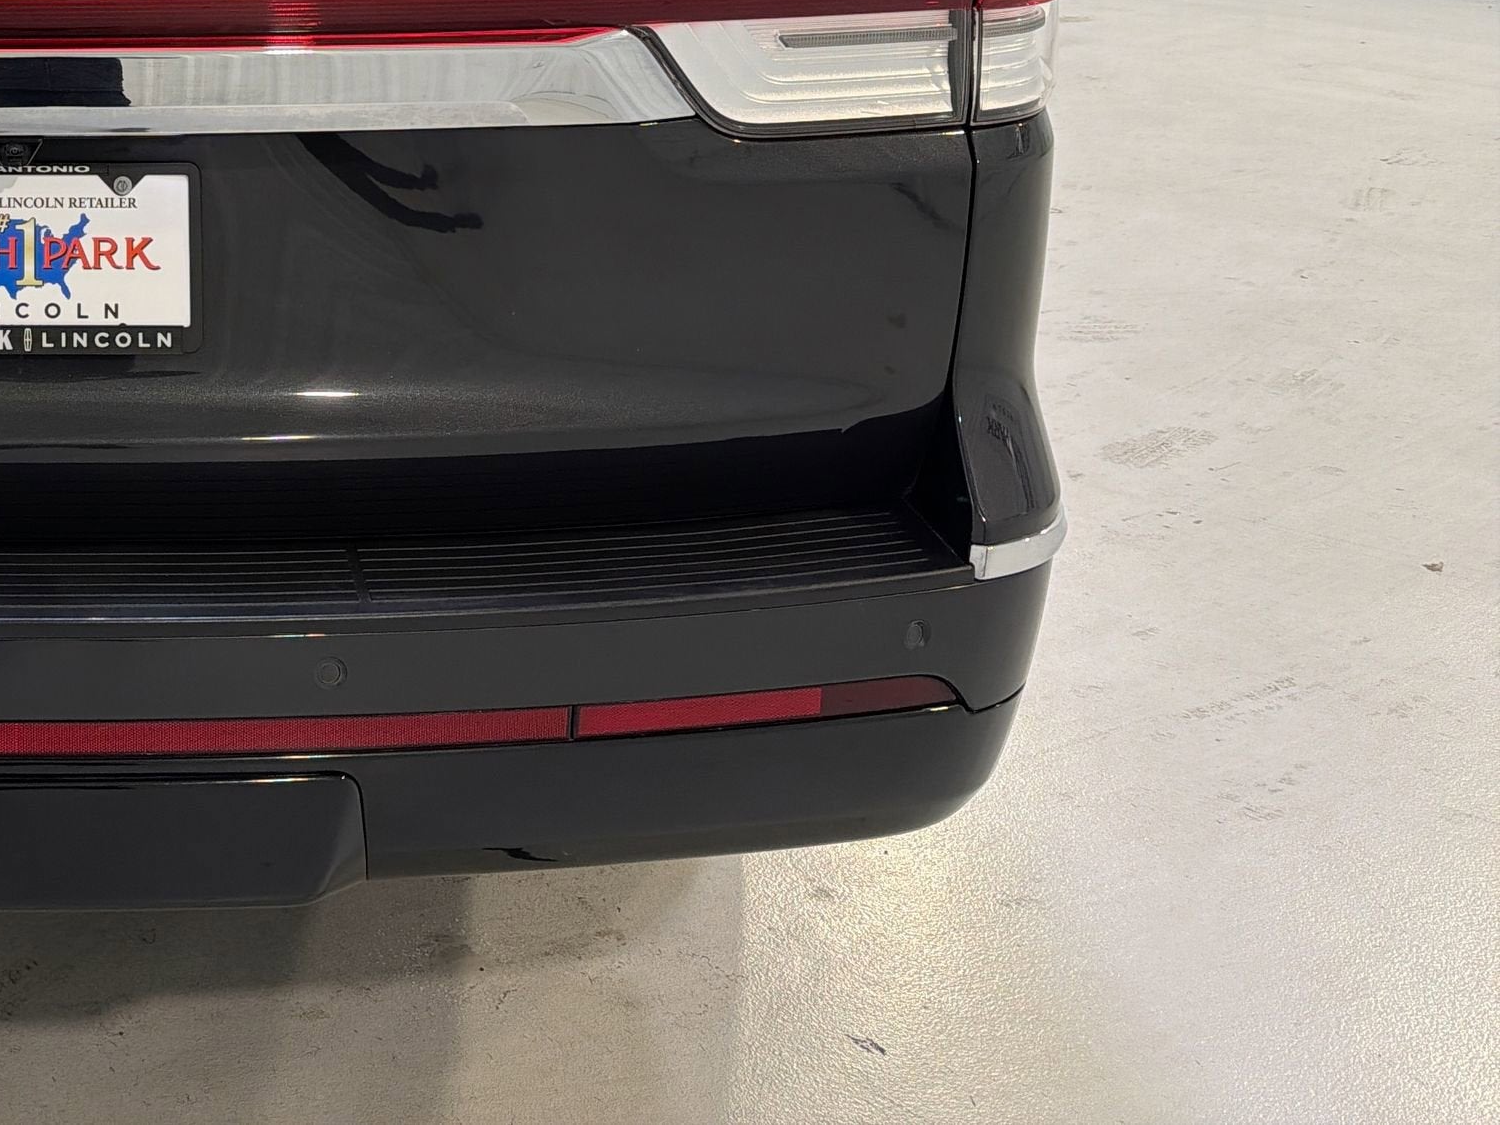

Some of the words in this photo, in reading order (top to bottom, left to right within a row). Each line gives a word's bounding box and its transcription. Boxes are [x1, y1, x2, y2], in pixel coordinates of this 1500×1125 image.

[69, 197, 138, 209] RETAILER
[42, 236, 162, 271] PARK
[42, 332, 172, 348] LINCOLN
